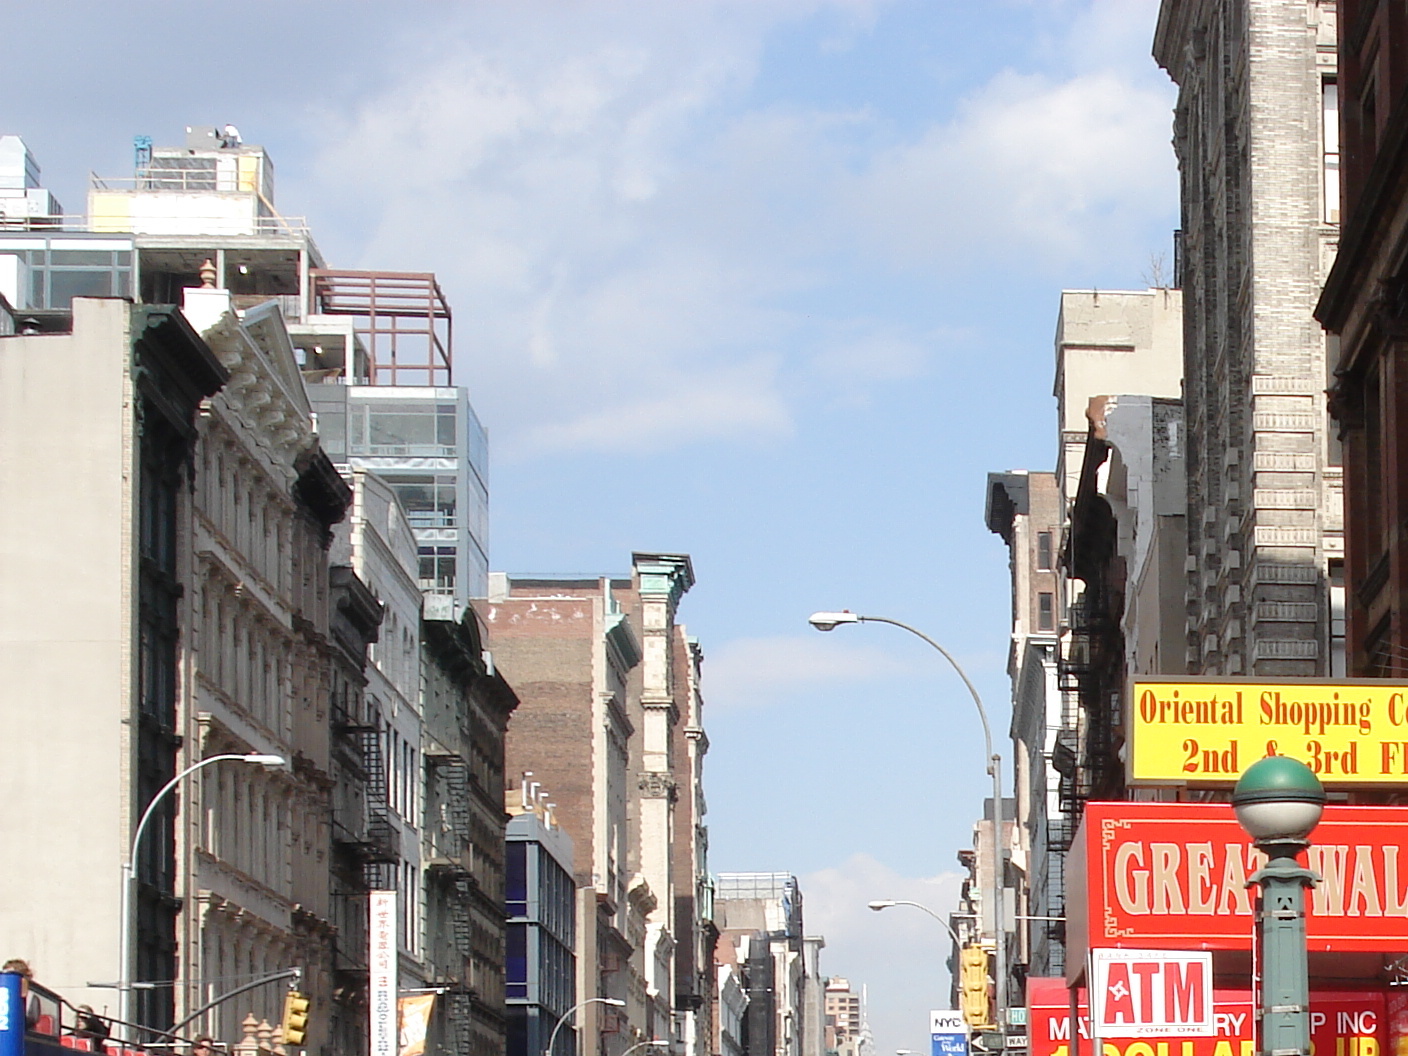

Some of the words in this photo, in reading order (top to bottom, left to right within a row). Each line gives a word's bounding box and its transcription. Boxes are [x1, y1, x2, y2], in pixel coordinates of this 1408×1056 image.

[1140, 689, 1243, 725] Oriental
[1260, 691, 1372, 736] Shopping
[1182, 738, 1239, 774] 2nd
[1306, 740, 1359, 775] 3rd
[1103, 962, 1204, 1024] ATM
[935, 1017, 961, 1028] NYC
[1011, 1009, 1027, 1022] HO
[1213, 1012, 1246, 1038] RY
[1337, 1011, 1377, 1033] INC
[1008, 1037, 1027, 1046] WAY
